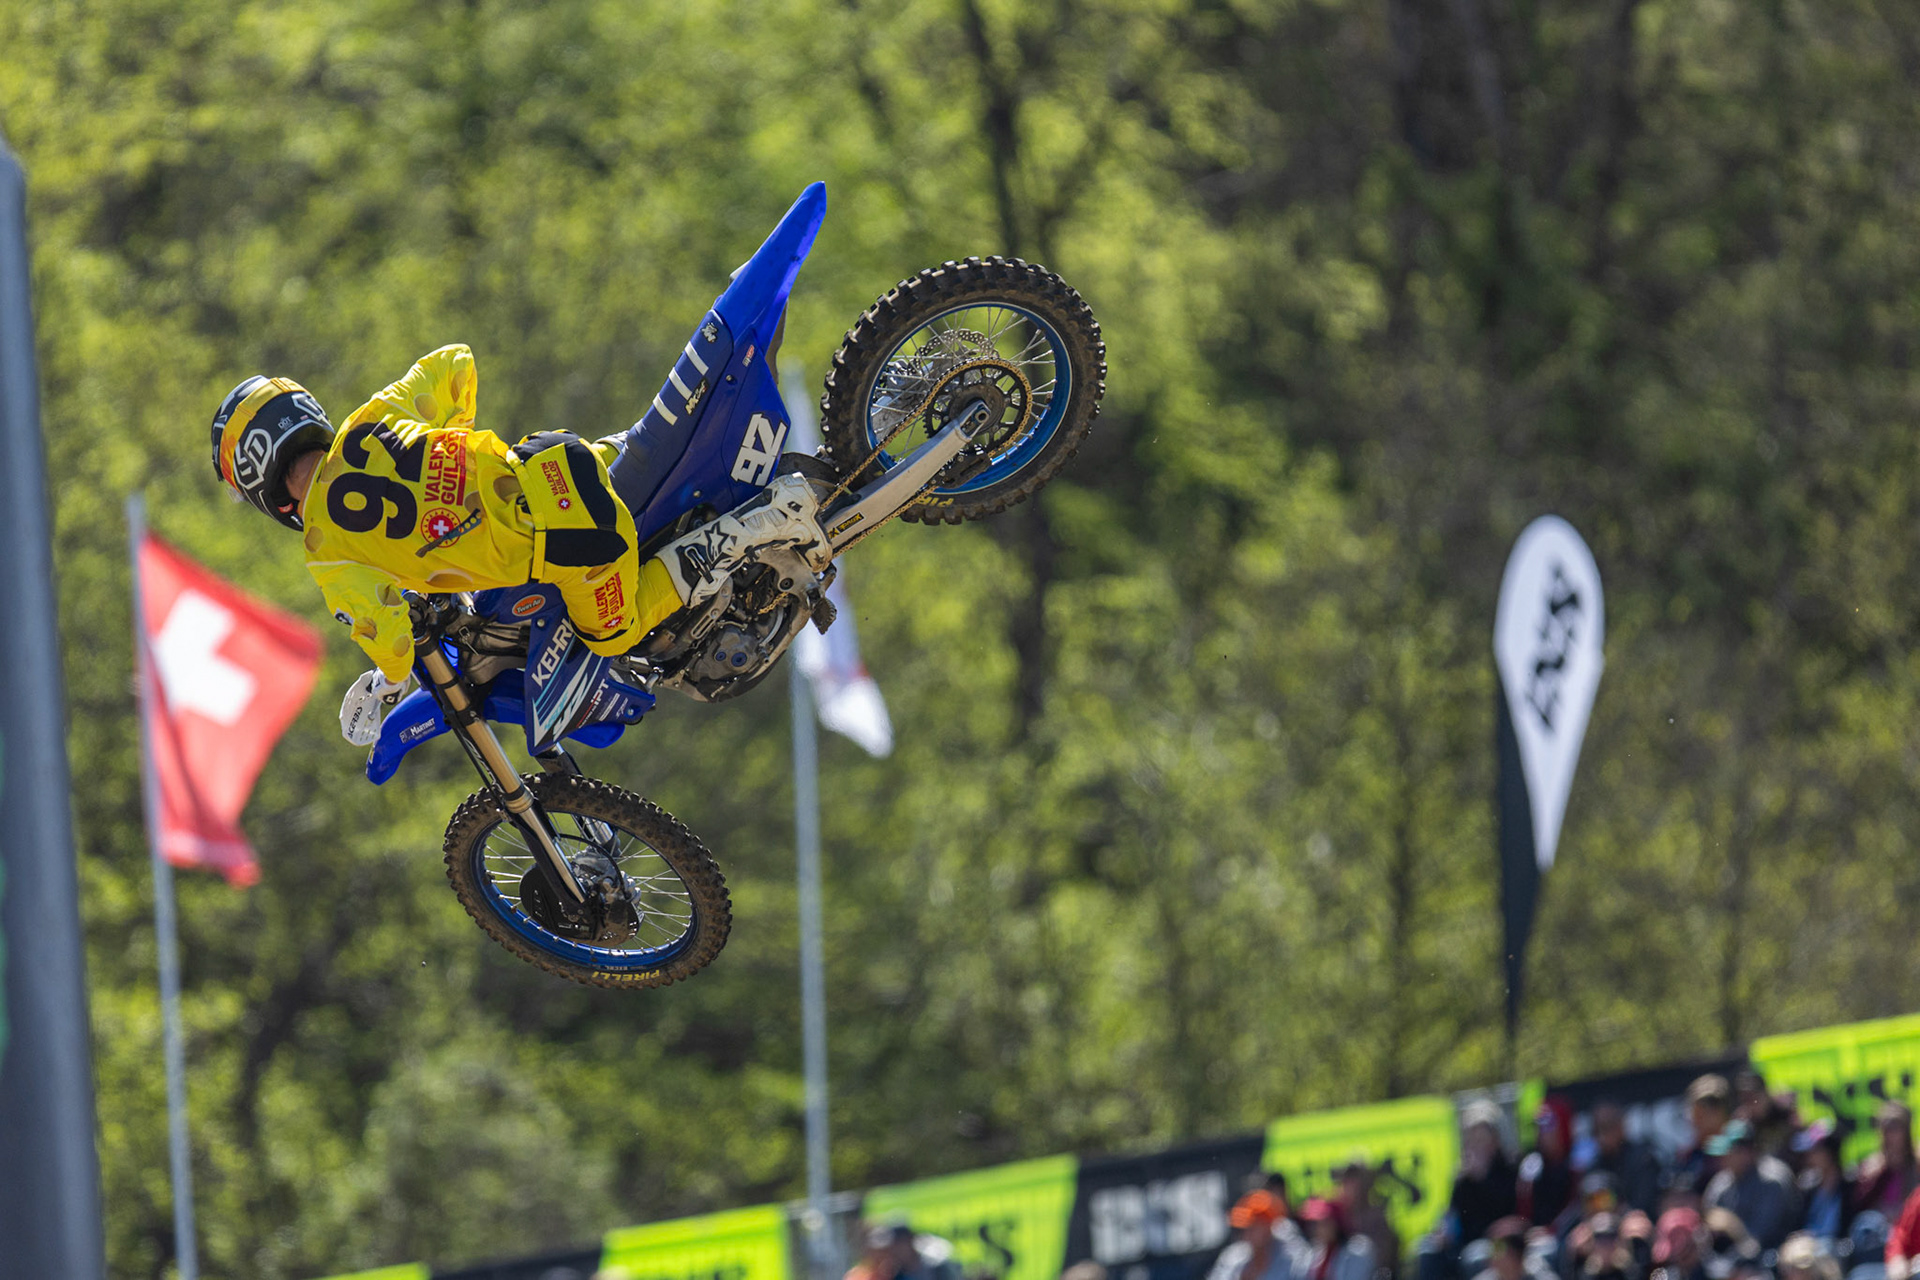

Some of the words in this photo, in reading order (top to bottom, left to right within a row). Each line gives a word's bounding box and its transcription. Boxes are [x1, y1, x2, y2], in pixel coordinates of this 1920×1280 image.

[730, 413, 788, 487] 92
[327, 422, 427, 539] 92
[541, 462, 558, 496] VALENTIN
[548, 460, 566, 495] GUILLOD
[516, 603, 532, 614] Twin
[532, 598, 542, 607] Air
[347, 706, 363, 739] ACERBIS
[591, 968, 660, 983] PIRELLI
